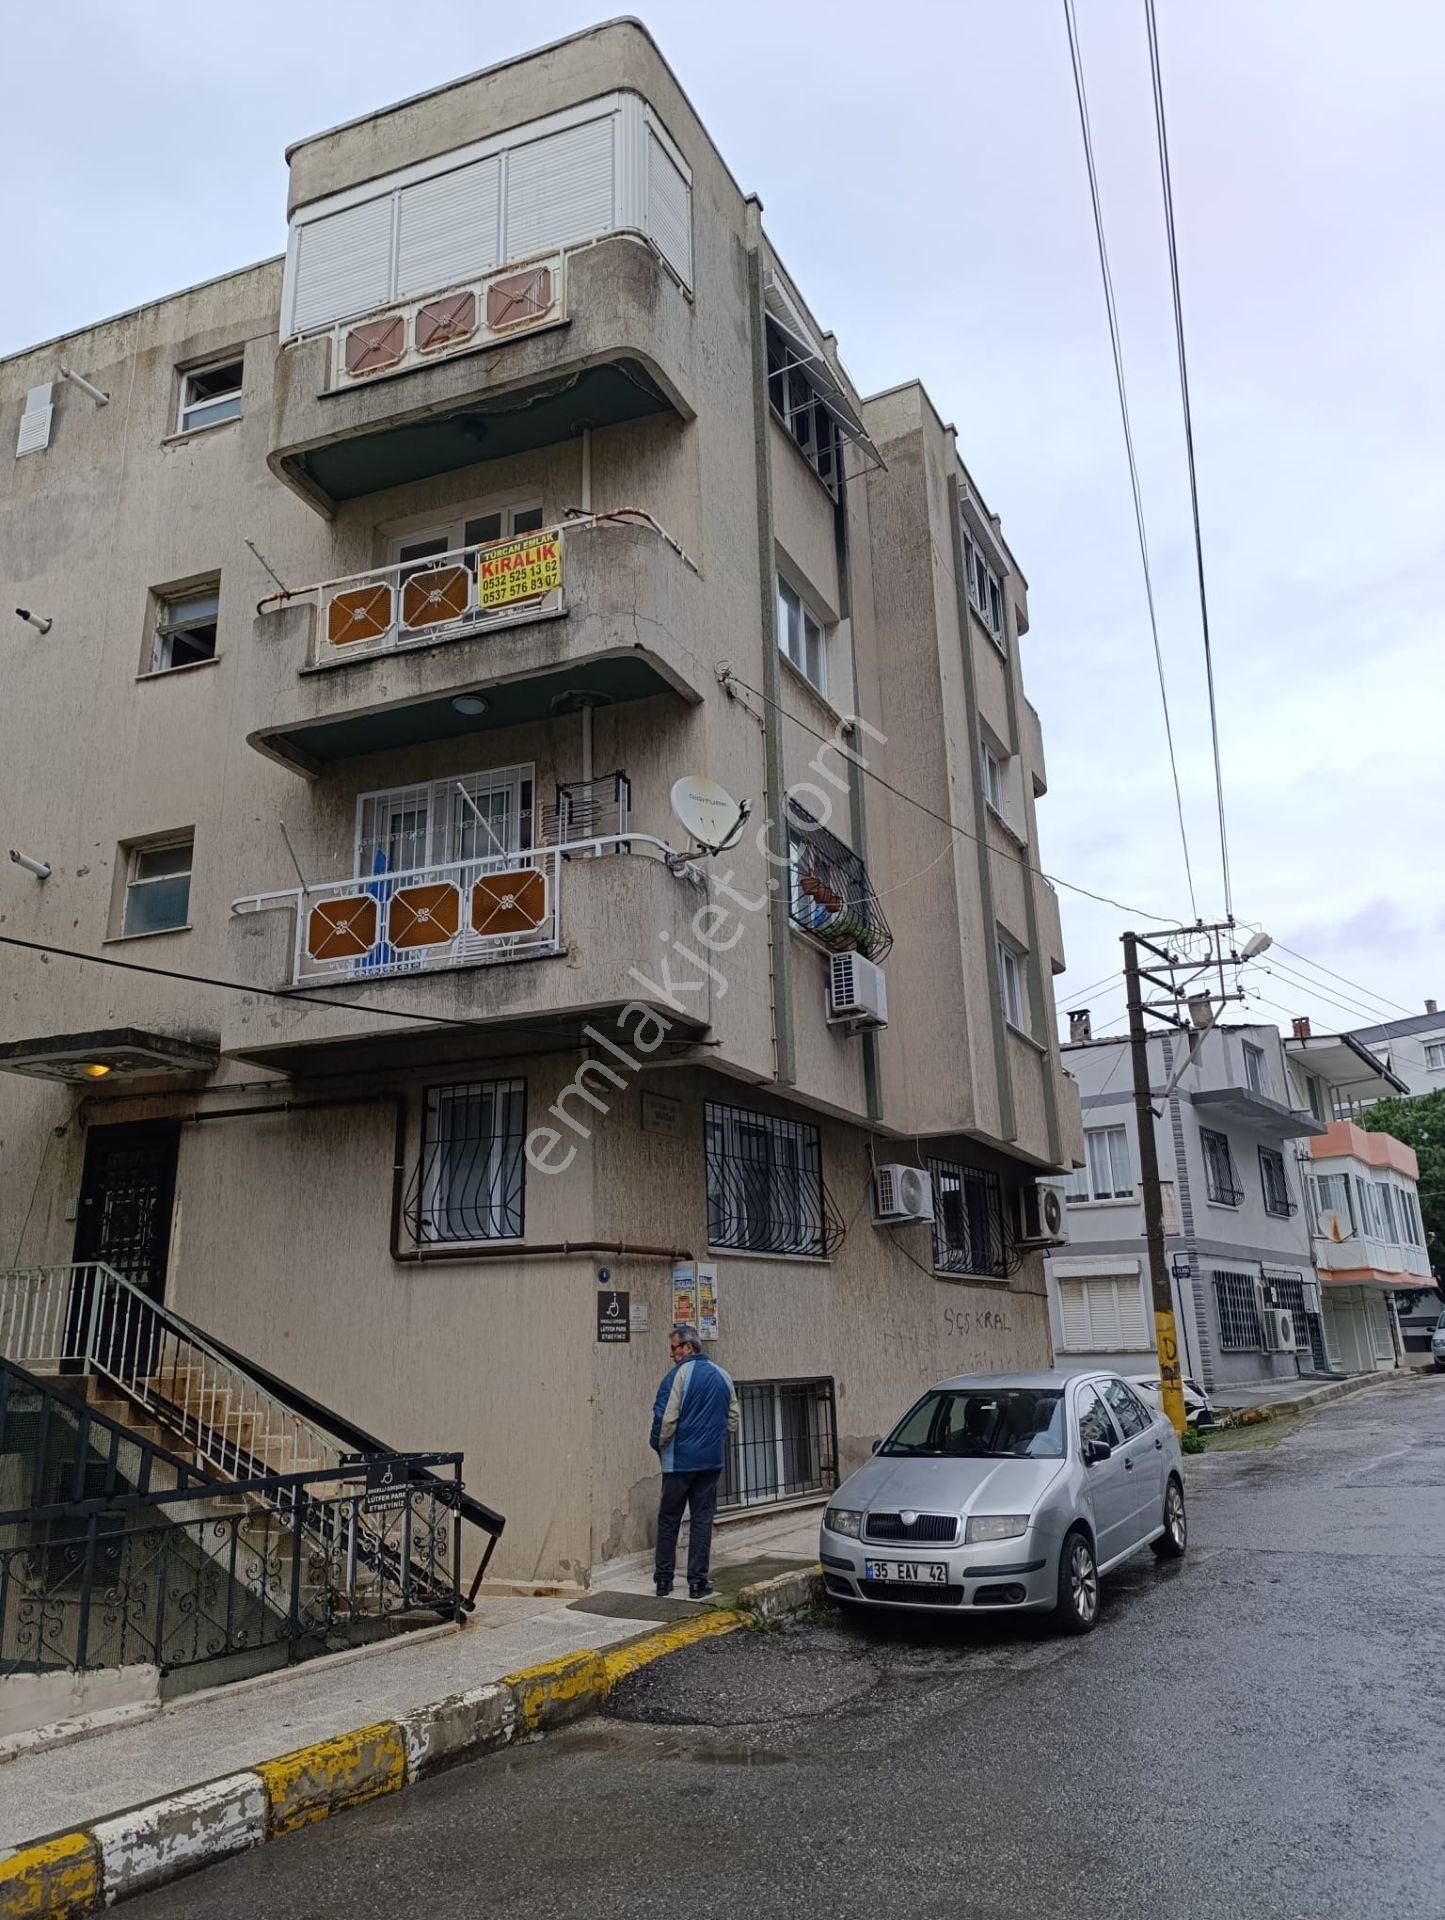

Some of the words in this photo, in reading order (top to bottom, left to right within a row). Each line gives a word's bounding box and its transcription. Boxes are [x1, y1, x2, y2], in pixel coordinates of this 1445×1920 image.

[523, 533, 554, 548] EMLAK
[483, 575, 506, 590] 0532
[510, 568, 527, 583] 525
[531, 563, 542, 576] 13
[545, 560, 557, 572] 62
[483, 588, 506, 604] 0537
[510, 582, 528, 596] 576
[531, 577, 543, 590] 83
[545, 573, 557, 586] 07
[975, 1311, 1011, 1332] KRAL
[874, 1563, 888, 1578] 35
[897, 1564, 919, 1580] EAV
[929, 1566, 944, 1582] 42
